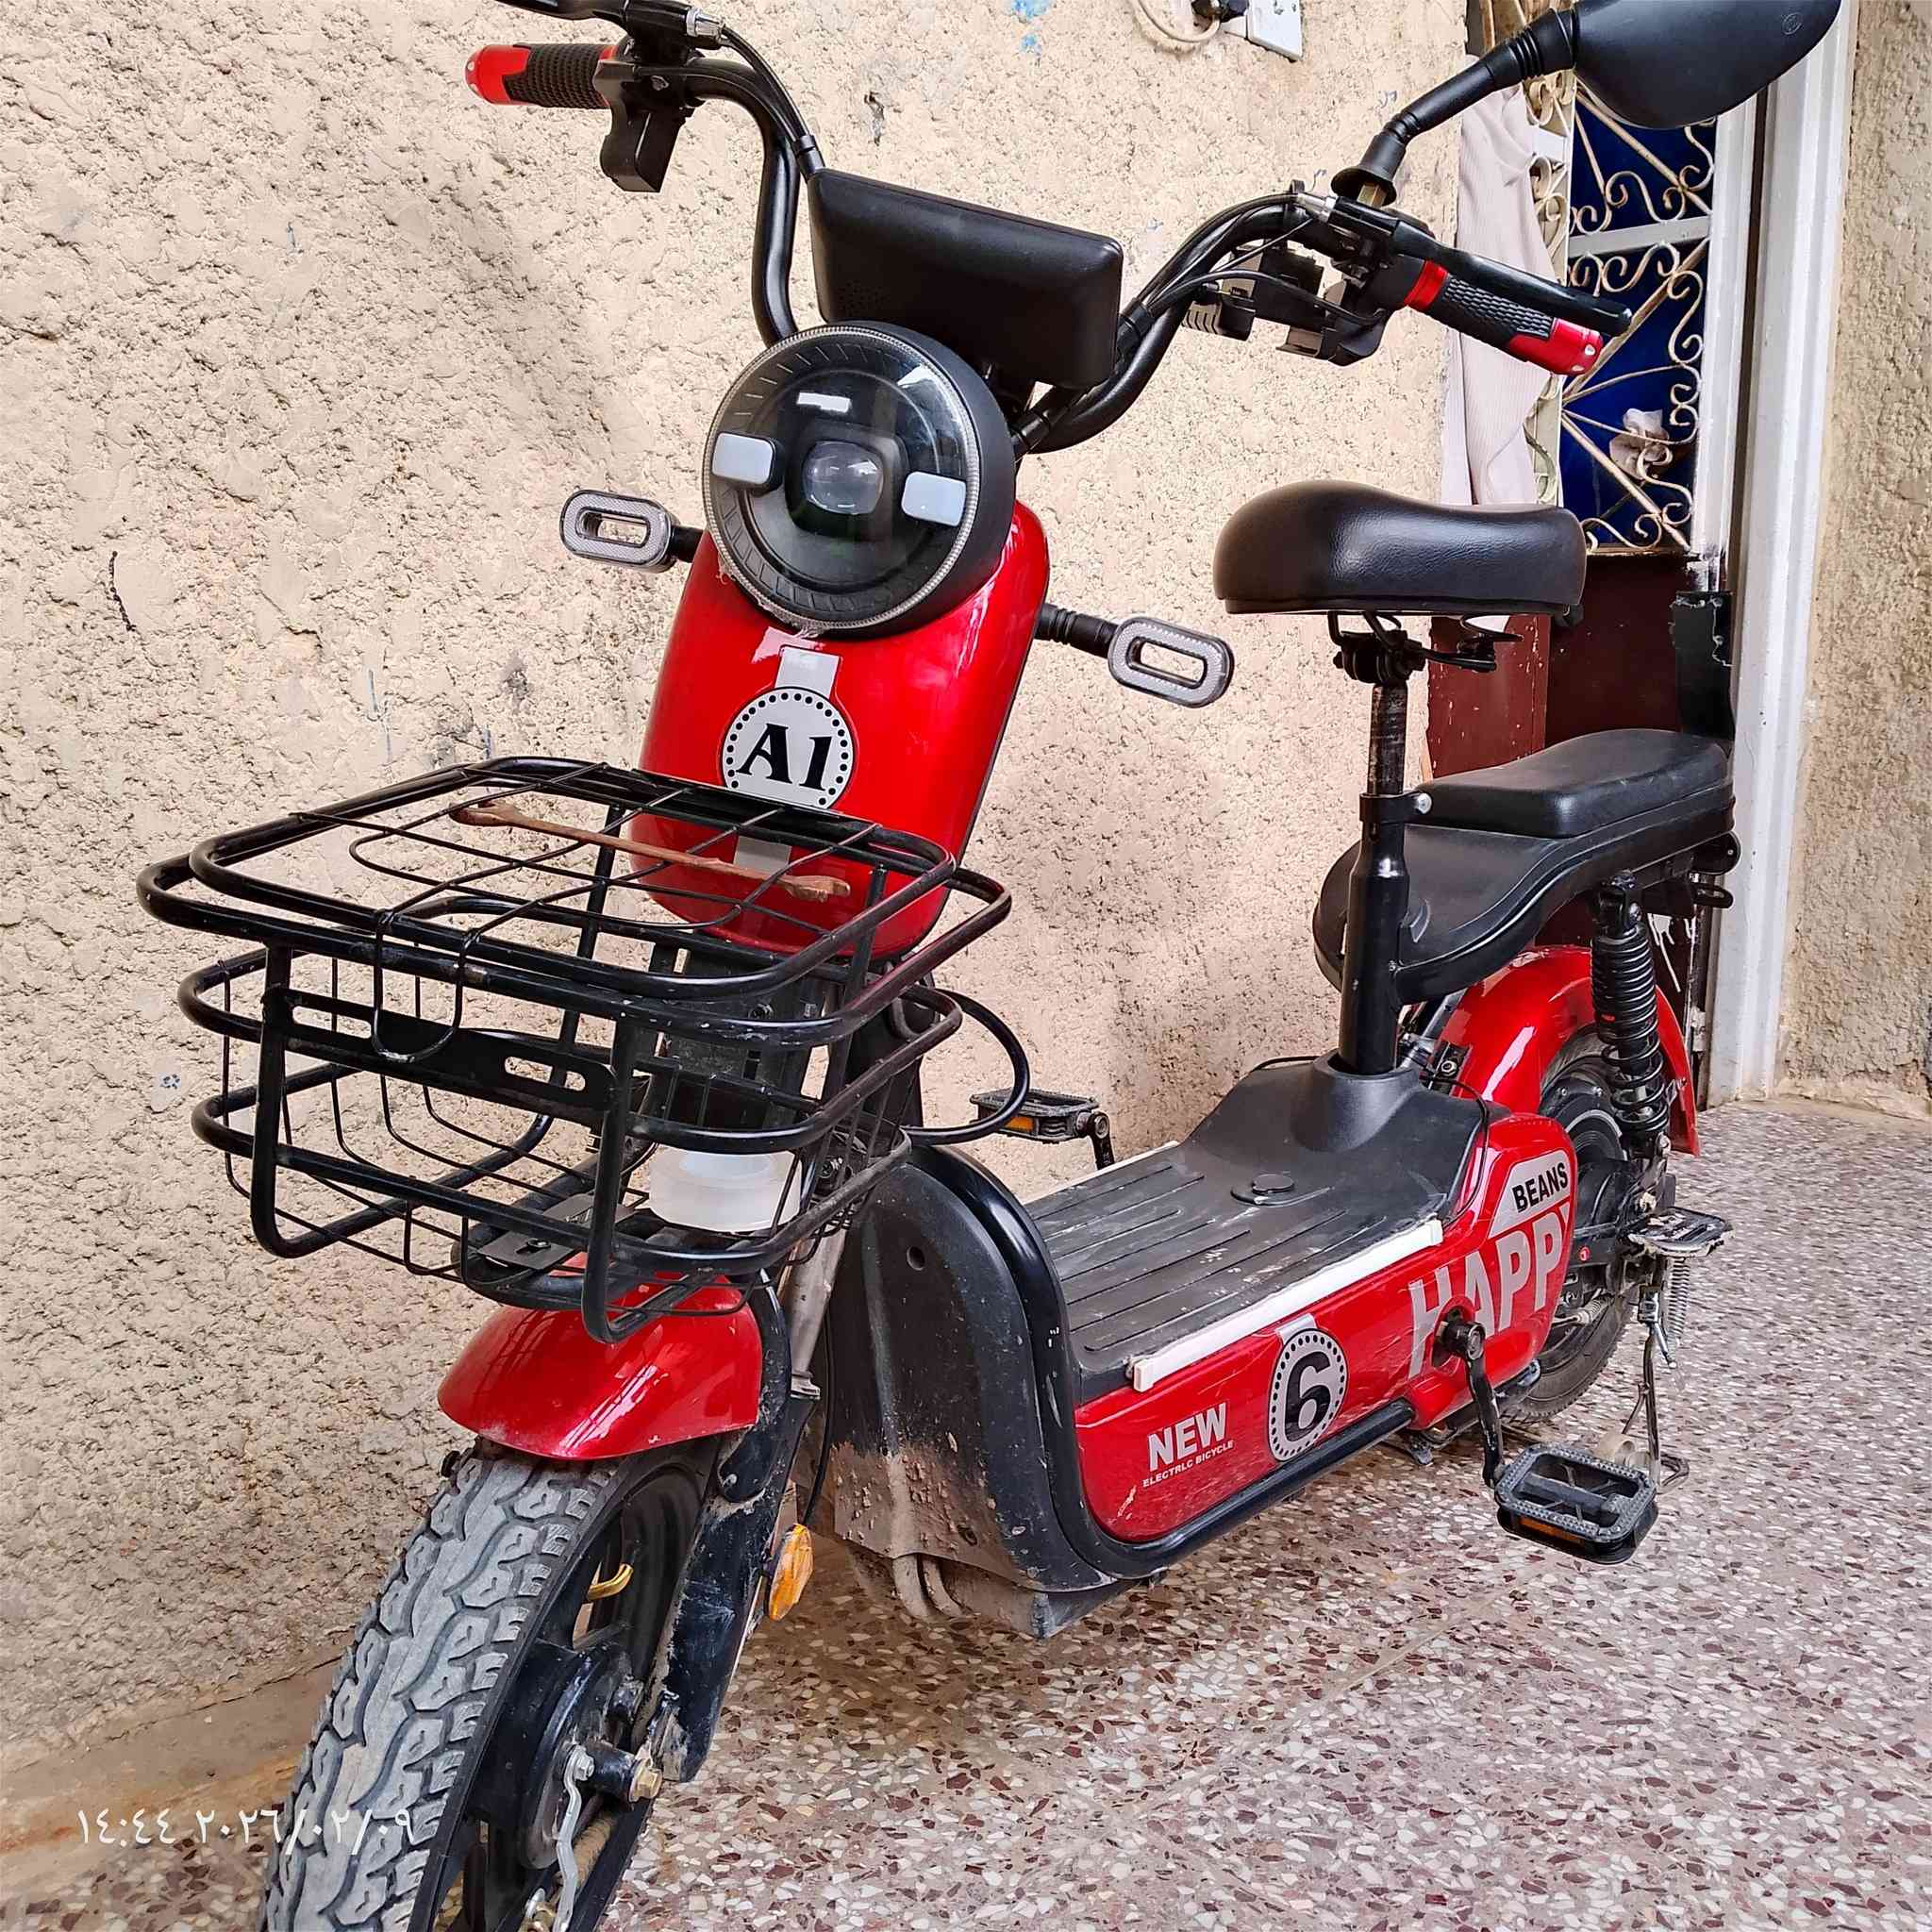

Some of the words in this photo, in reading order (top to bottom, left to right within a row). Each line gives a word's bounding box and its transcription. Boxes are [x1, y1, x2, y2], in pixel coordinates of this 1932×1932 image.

[735, 723, 832, 791] A1
[1511, 1161, 1570, 1214] BEANS
[1407, 1201, 1572, 1379] HAPP
[1284, 1351, 1331, 1442] 6
[1148, 1402, 1227, 1472] NEW
[1194, 1440, 1235, 1465] BICYCLE
